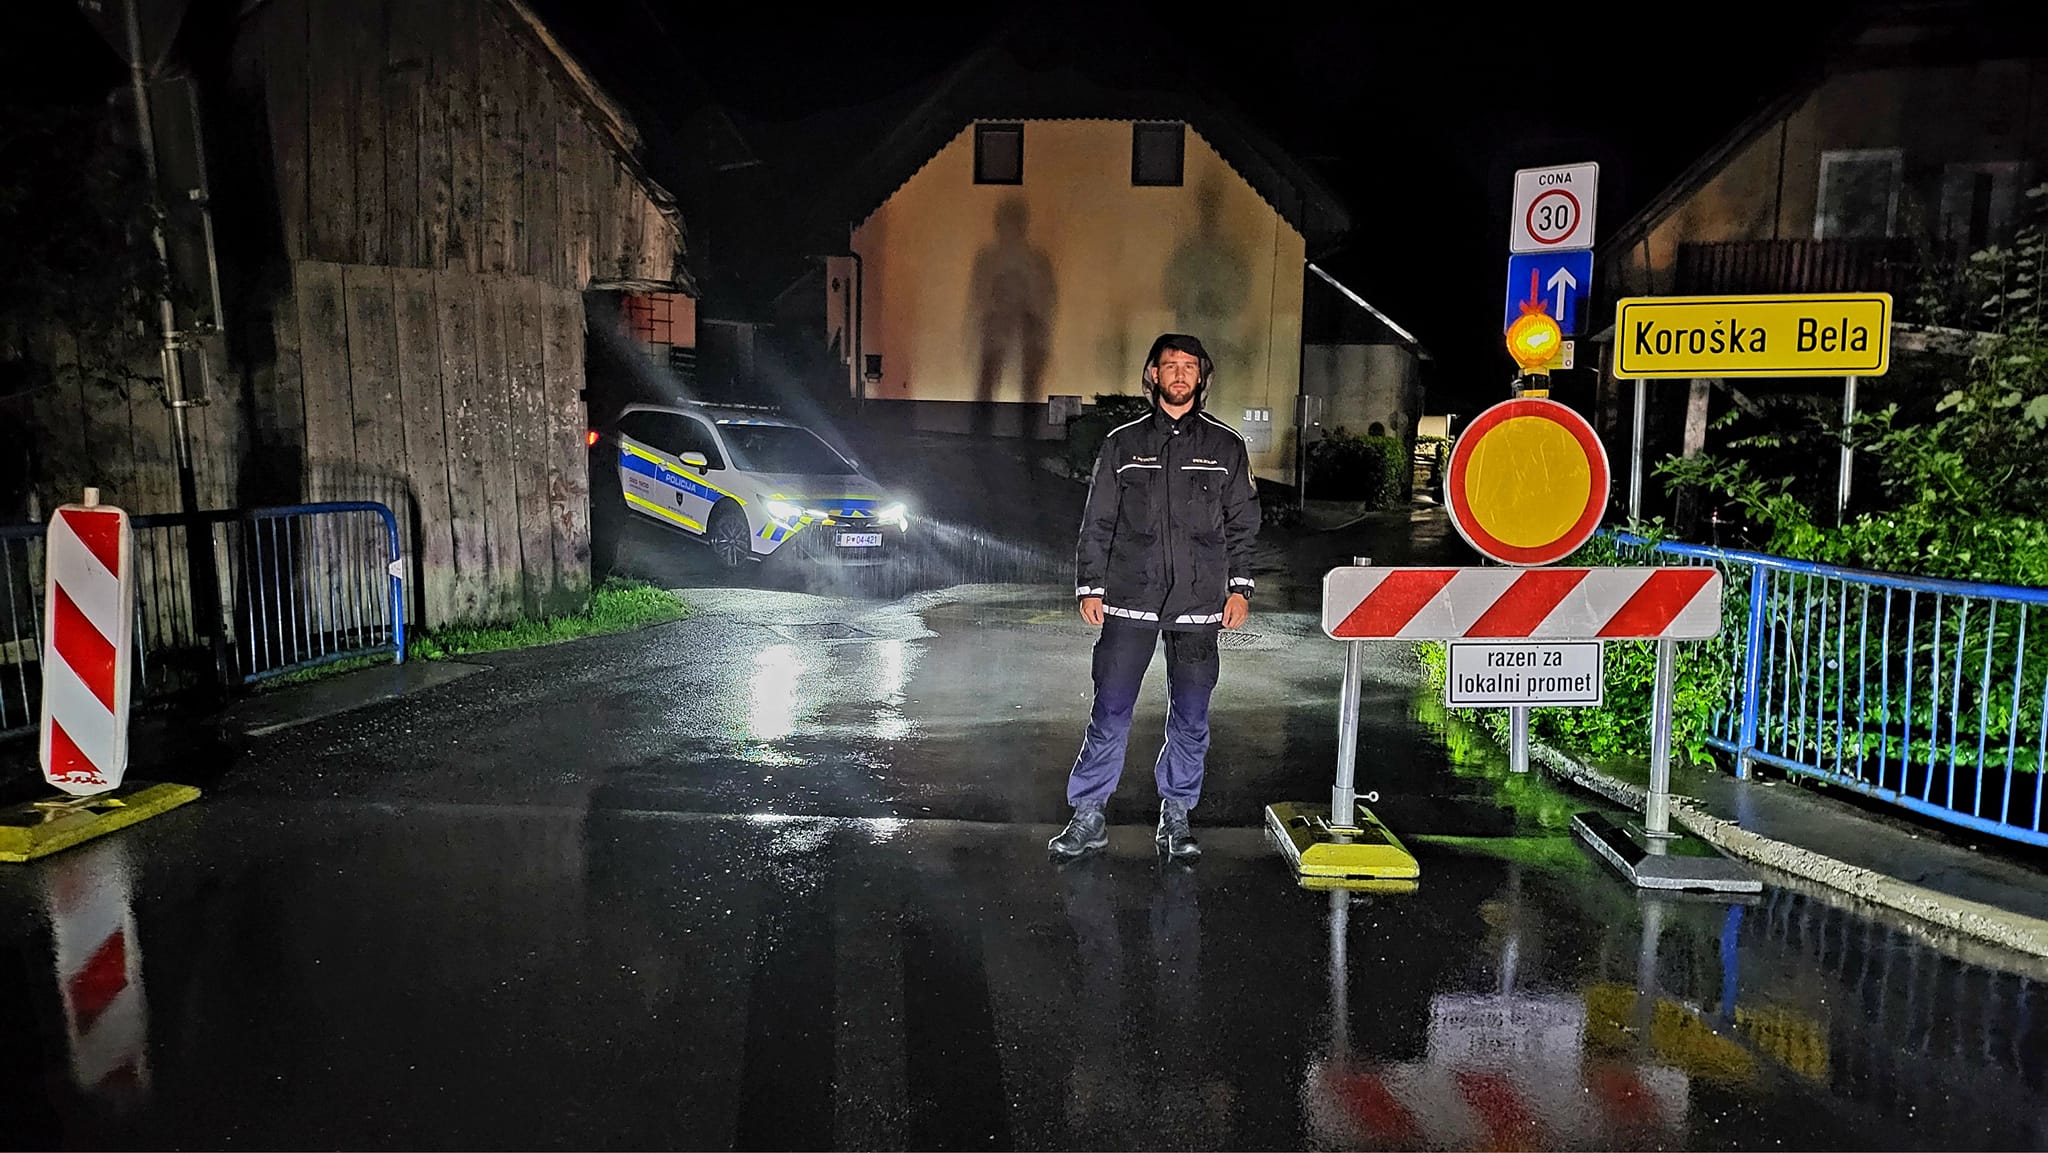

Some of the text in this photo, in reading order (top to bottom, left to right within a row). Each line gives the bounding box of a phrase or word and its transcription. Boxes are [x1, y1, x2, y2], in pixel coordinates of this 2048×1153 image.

[1538, 172, 1573, 186] CONA
[1538, 204, 1569, 231] 30
[1635, 317, 1868, 355] Koroška Bela
[665, 474, 697, 493] POLICIJA
[1488, 651, 1562, 667] razen za
[1458, 673, 1591, 697] lokalni promet
